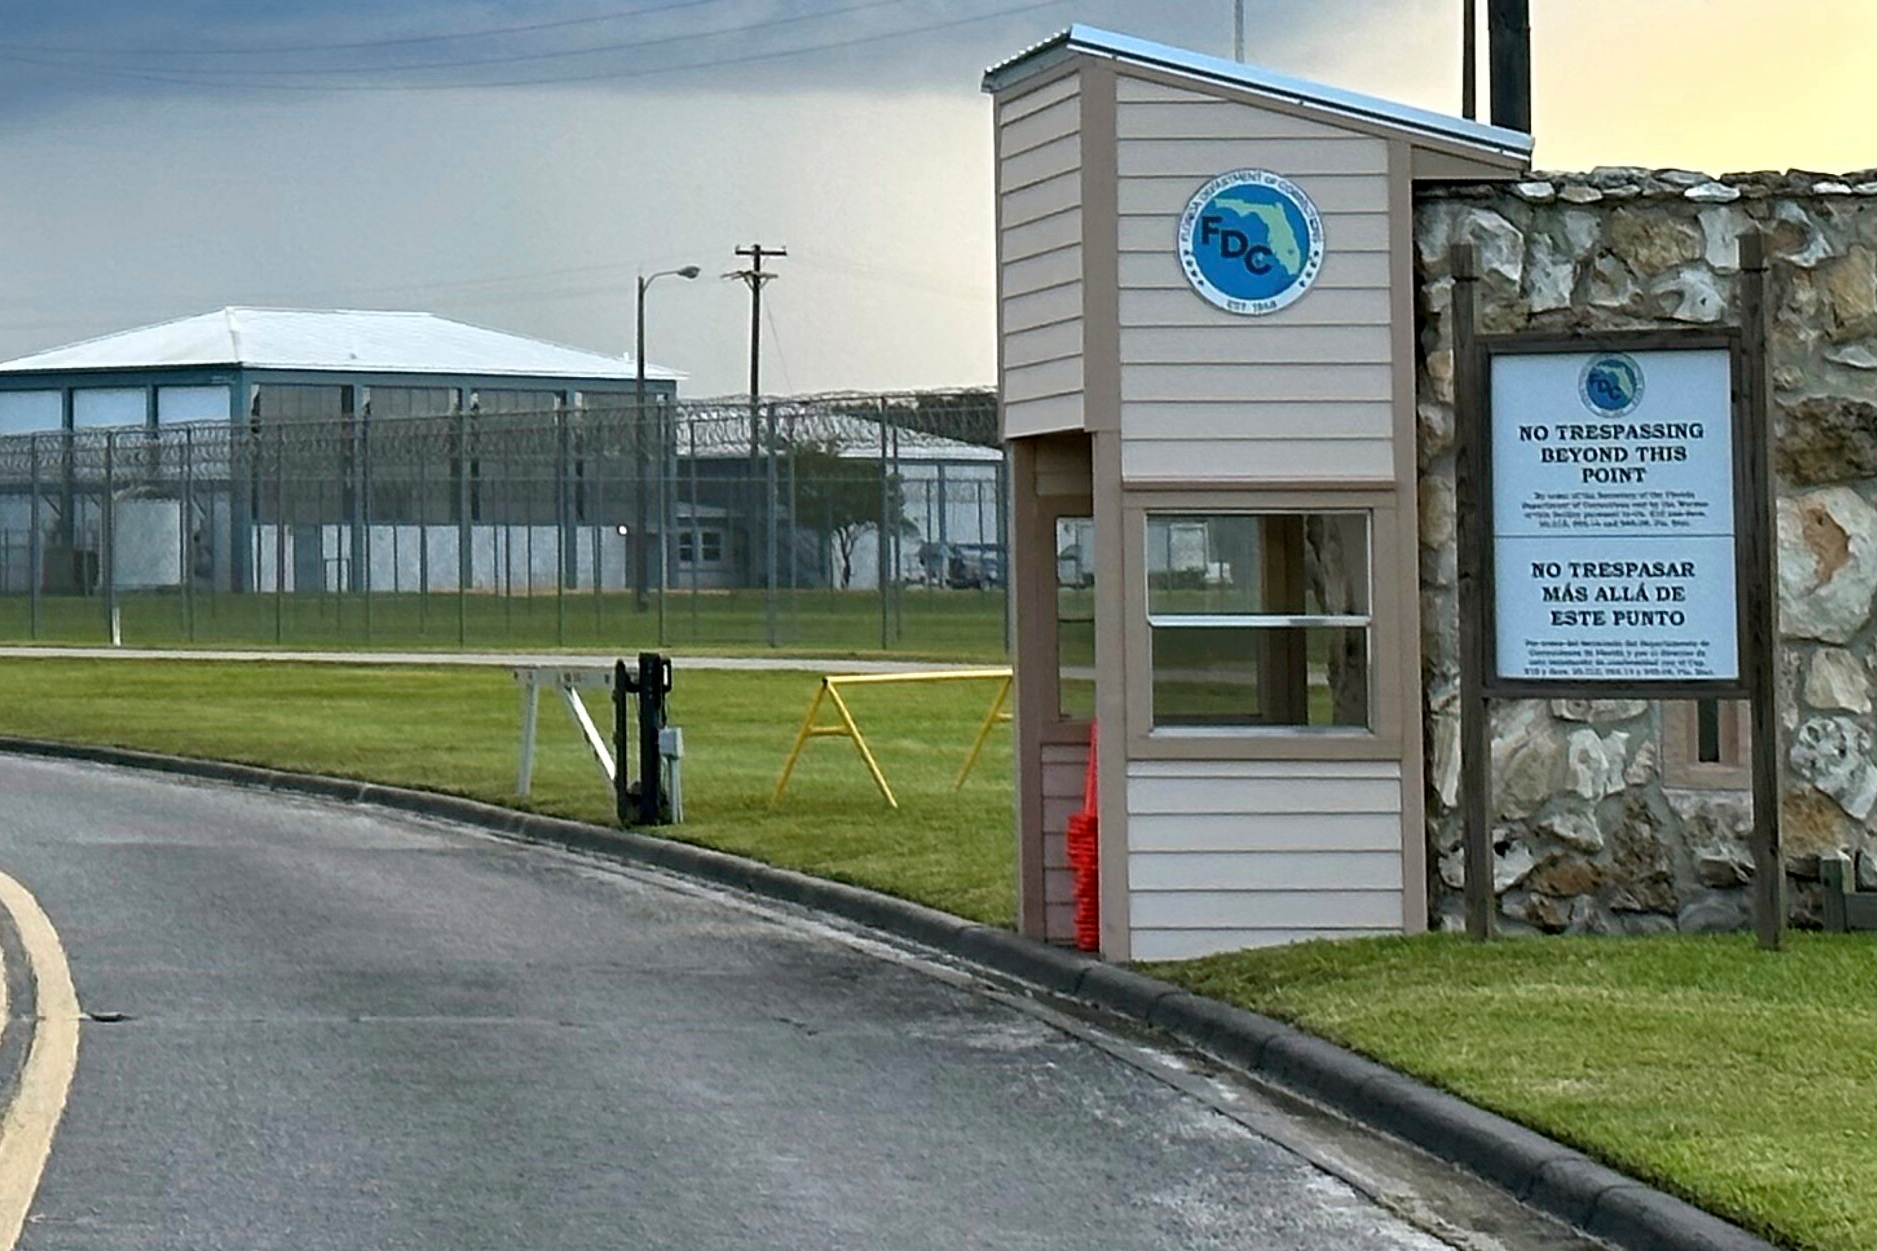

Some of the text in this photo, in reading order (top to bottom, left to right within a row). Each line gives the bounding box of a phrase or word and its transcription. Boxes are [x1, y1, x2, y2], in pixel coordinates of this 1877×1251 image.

[1201, 215, 1273, 275] FDC
[1519, 423, 1704, 441] NO TRESPASSING
[1541, 446, 1687, 463] BEYOND THIS
[1582, 467, 1647, 483] POINT
[1531, 561, 1695, 578] NO TRESPASAR
[1542, 582, 1686, 602] MÁS ALLÁ DE
[1551, 610, 1685, 627] ESTE PUNTO
